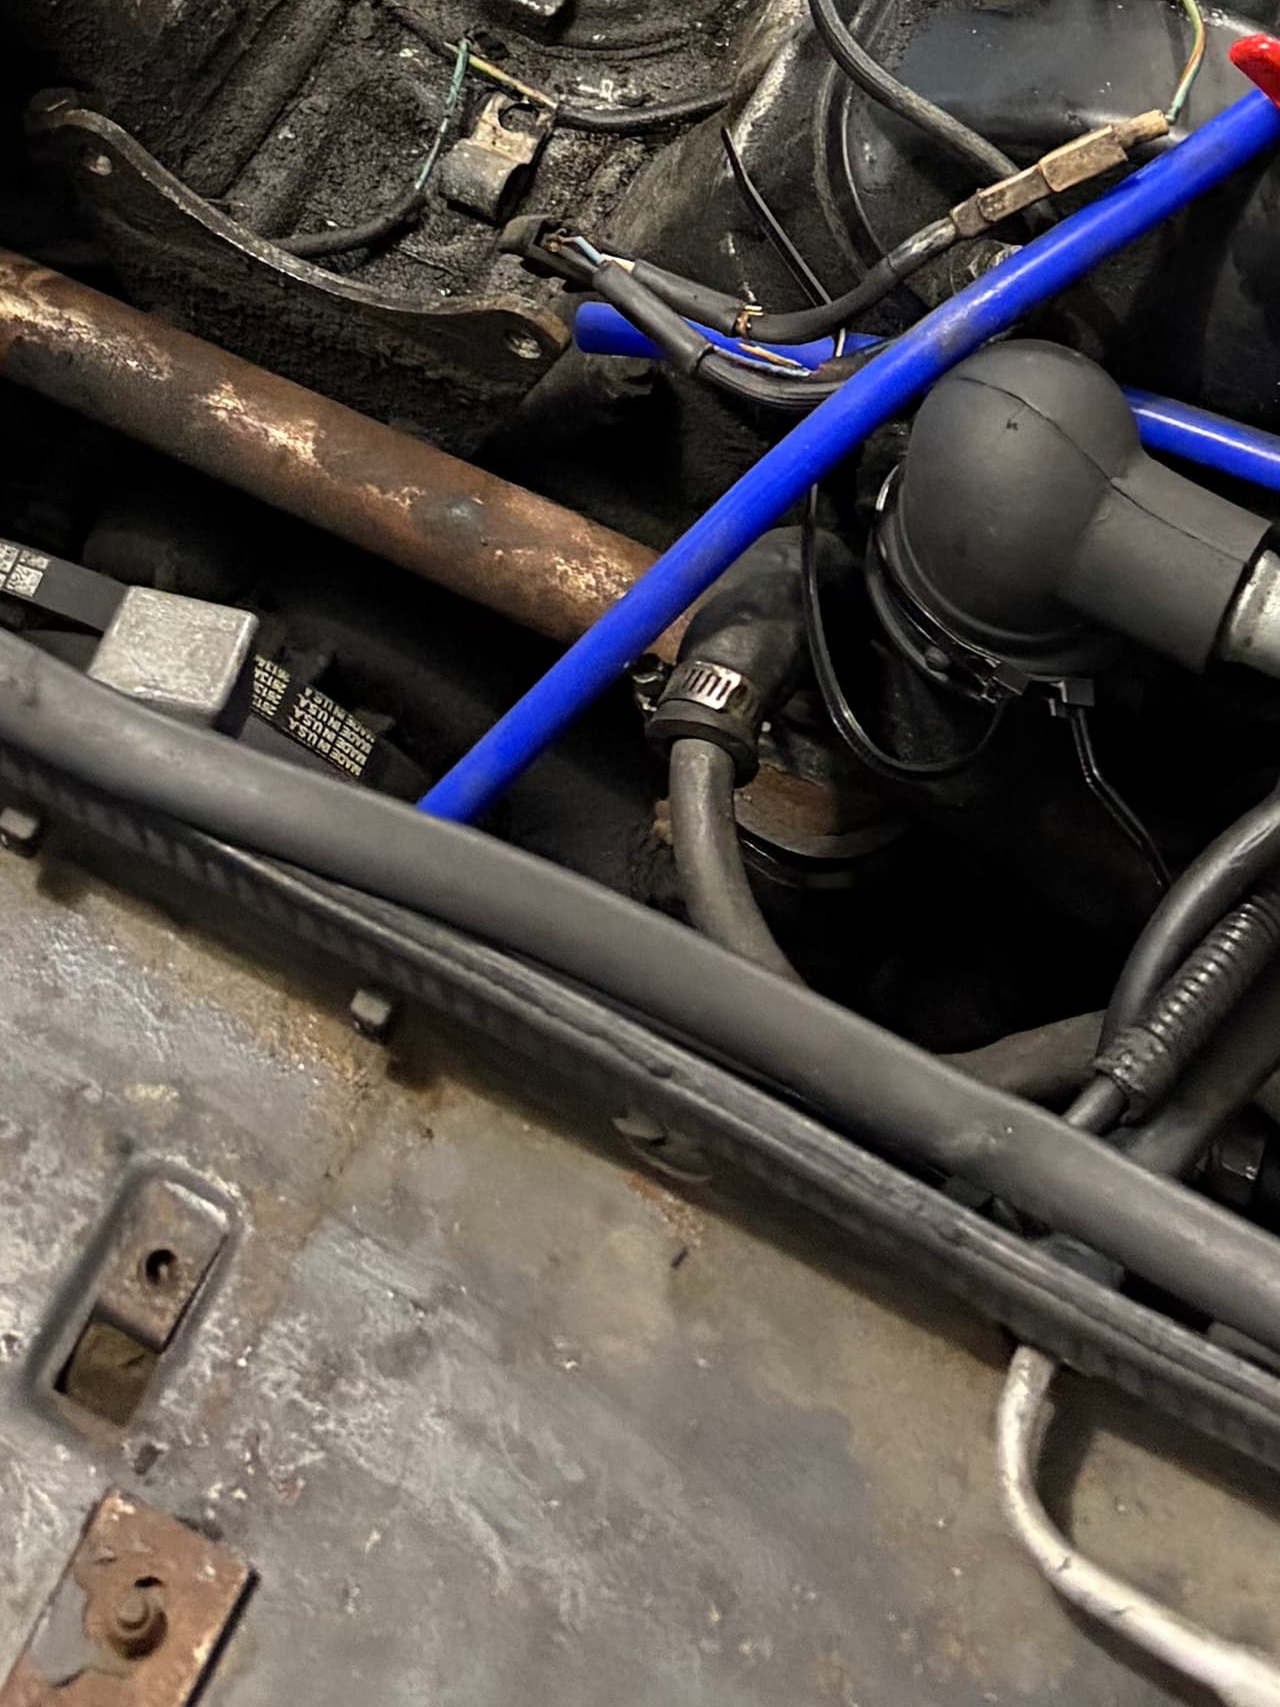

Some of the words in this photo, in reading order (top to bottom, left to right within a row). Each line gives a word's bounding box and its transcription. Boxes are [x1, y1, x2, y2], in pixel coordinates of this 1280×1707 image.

[333, 735, 369, 765] MADE
[338, 725, 373, 754] MADE
[328, 747, 364, 776] MADE
